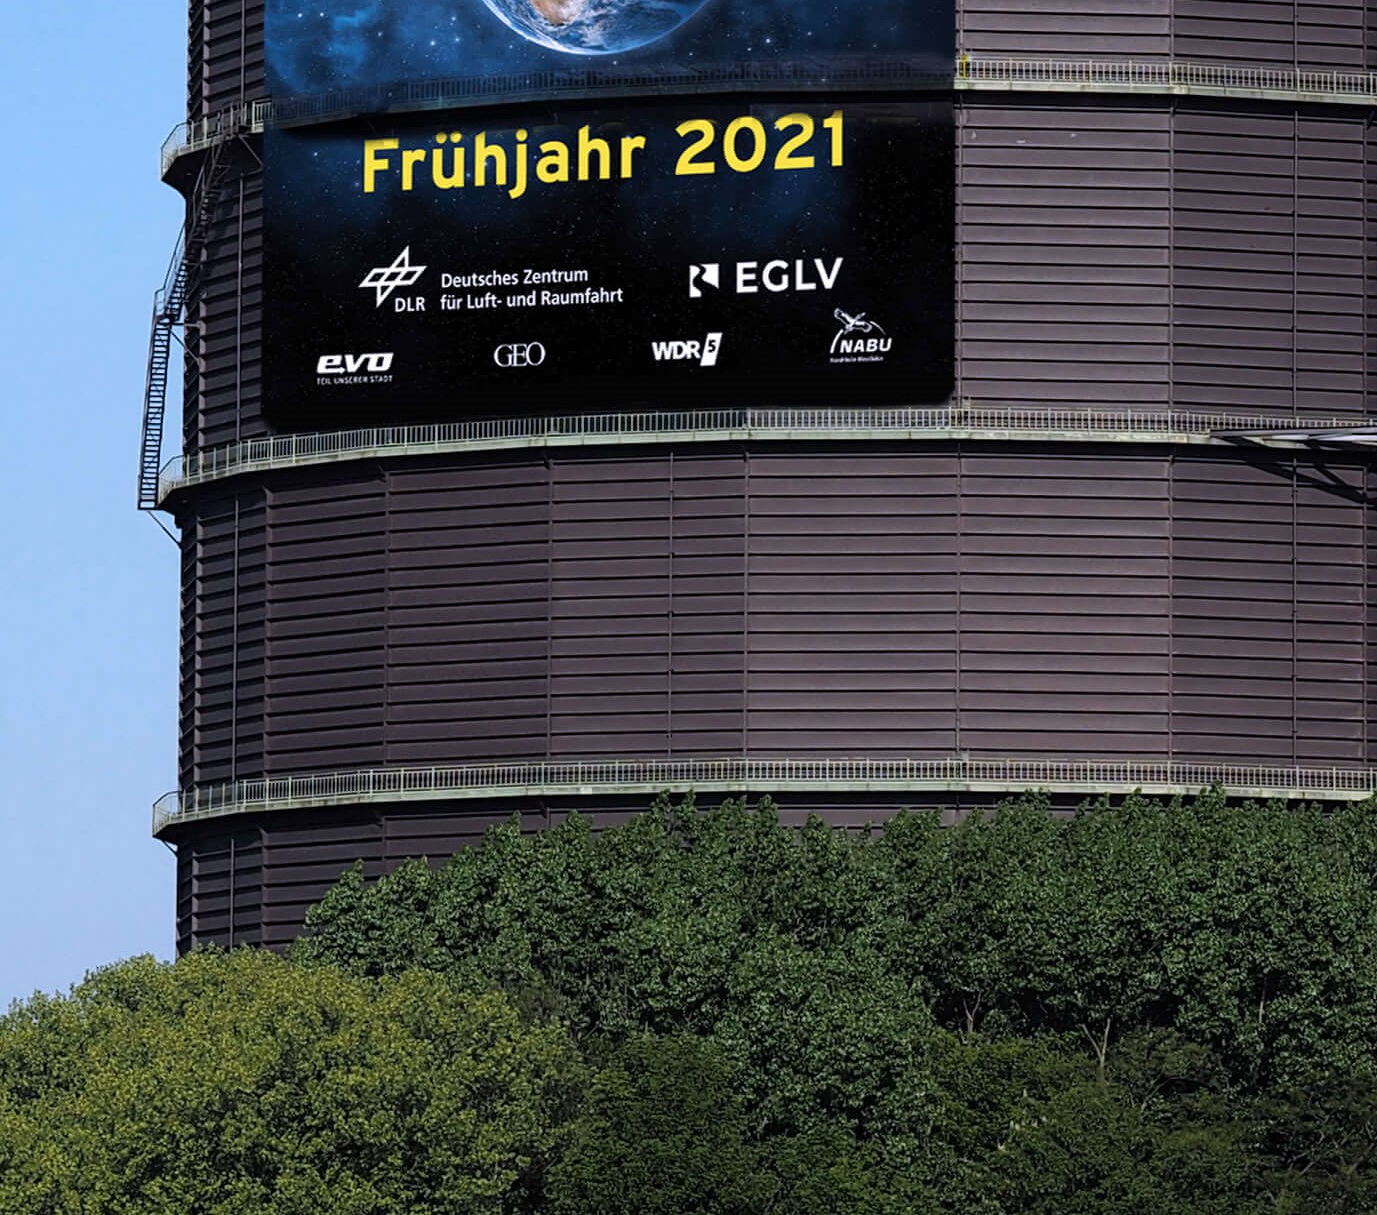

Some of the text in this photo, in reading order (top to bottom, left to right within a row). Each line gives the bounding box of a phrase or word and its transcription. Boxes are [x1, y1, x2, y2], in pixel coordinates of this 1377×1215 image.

[363, 111, 843, 200] Frühjahr 2021
[441, 269, 589, 289] Deutsches Zentrum
[736, 257, 844, 293] EGLV
[394, 296, 426, 313] DLR
[440, 287, 624, 311] für Luft- und Raumfahrt
[493, 341, 546, 368] GEO
[651, 340, 701, 361] WDR
[839, 337, 893, 354] NABU
